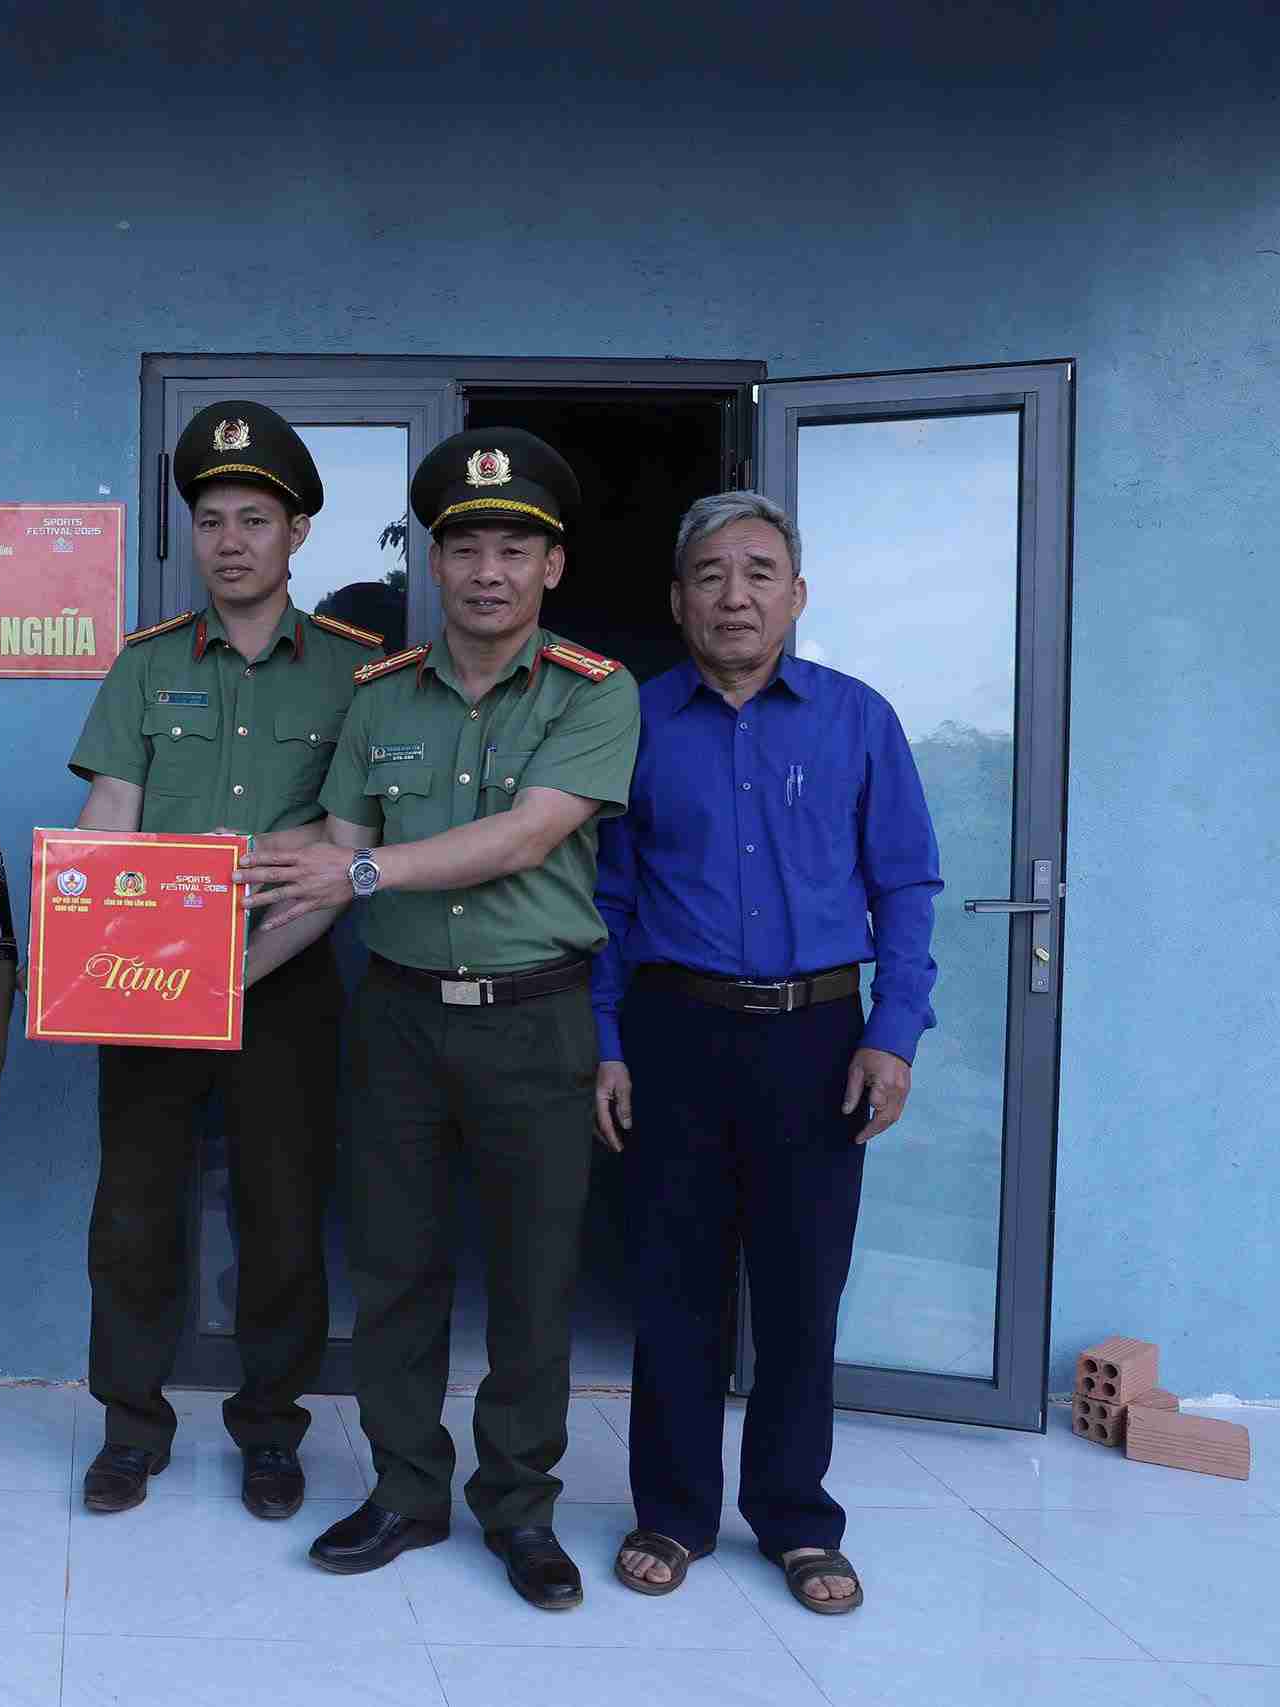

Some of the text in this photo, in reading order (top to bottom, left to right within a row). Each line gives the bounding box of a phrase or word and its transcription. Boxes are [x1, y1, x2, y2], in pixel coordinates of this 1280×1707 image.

[43, 518, 82, 526] SPORTS
[25, 527, 102, 536] FESTIVAL 2025
[0, 607, 96, 656] NGHĨA
[176, 875, 211, 884] SPORTS
[160, 882, 200, 892] FESTIVAL
[86, 953, 192, 1001] Tặng
